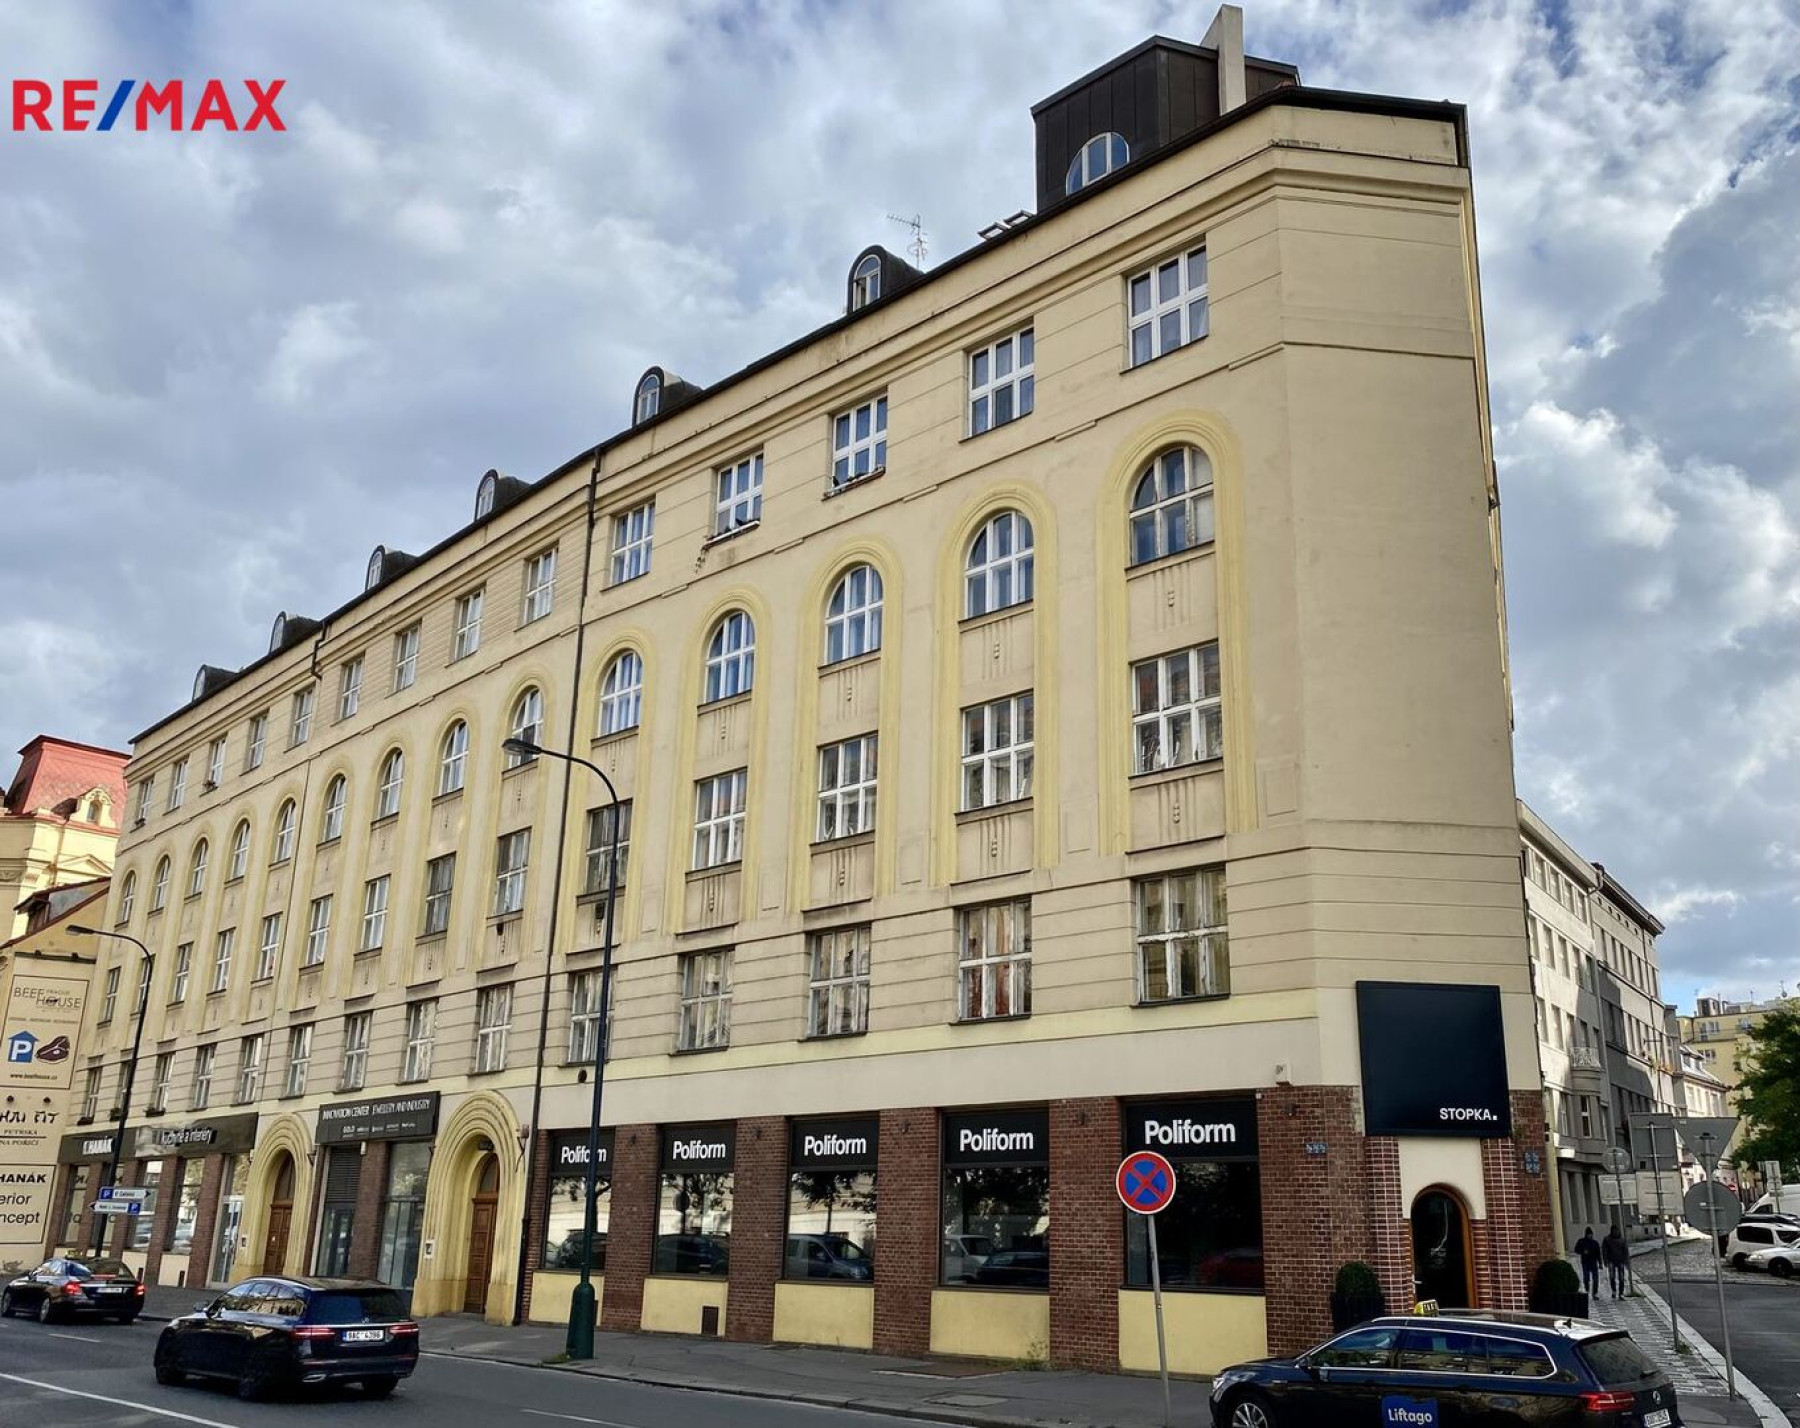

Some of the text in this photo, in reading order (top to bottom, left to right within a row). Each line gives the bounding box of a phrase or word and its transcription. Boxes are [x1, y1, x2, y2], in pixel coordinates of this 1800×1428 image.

[13, 987, 45, 998] BEEF
[36, 996, 82, 1008] HOUSE
[959, 1128, 1034, 1152] Poliform
[1144, 1119, 1236, 1145] Poliform
[560, 1145, 607, 1163] Polifom
[672, 1139, 727, 1160] Poliform
[803, 1134, 867, 1157] Poliform
[1388, 1408, 1433, 1425] Liftago
